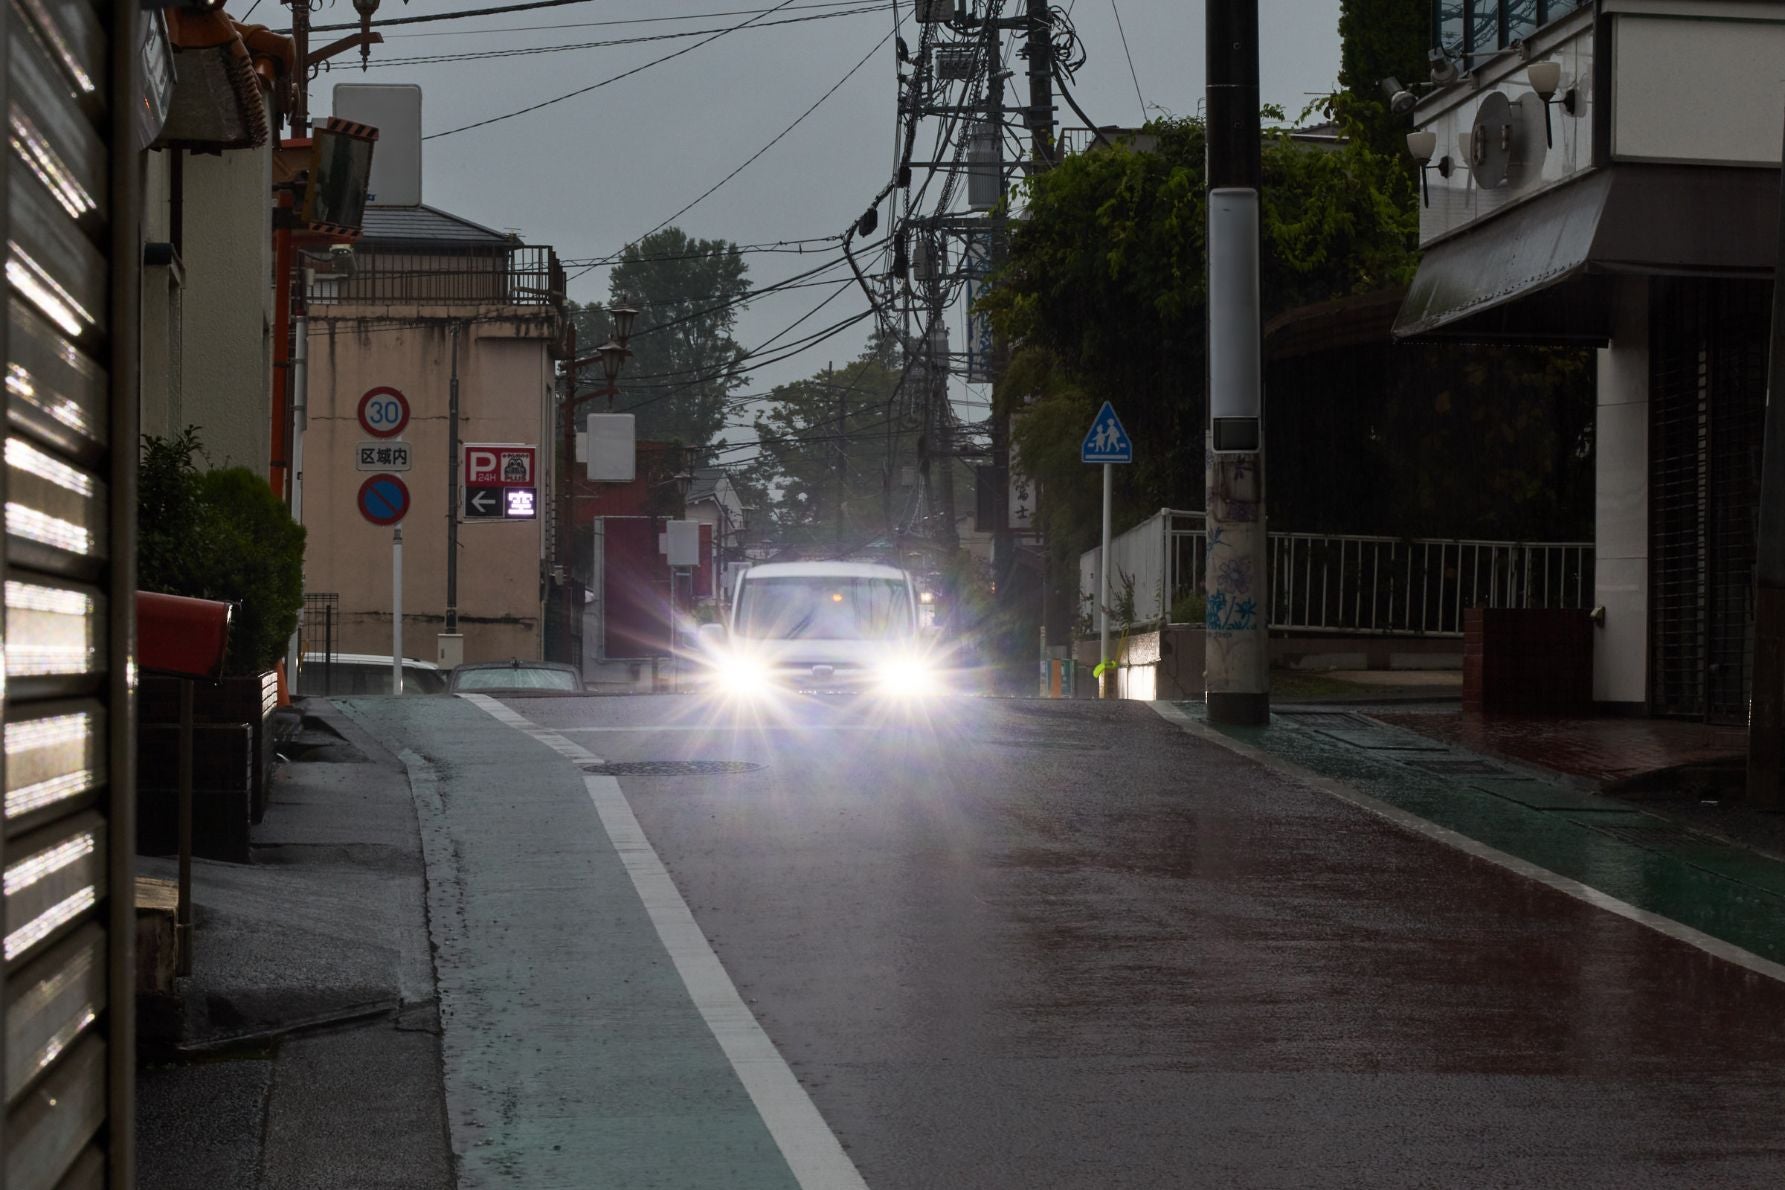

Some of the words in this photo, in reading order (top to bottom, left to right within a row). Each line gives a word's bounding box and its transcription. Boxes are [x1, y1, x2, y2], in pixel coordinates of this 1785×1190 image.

[370, 401, 399, 424] 30
[361, 447, 407, 465] 区域内
[470, 451, 497, 482] P
[478, 473, 497, 482] 24H
